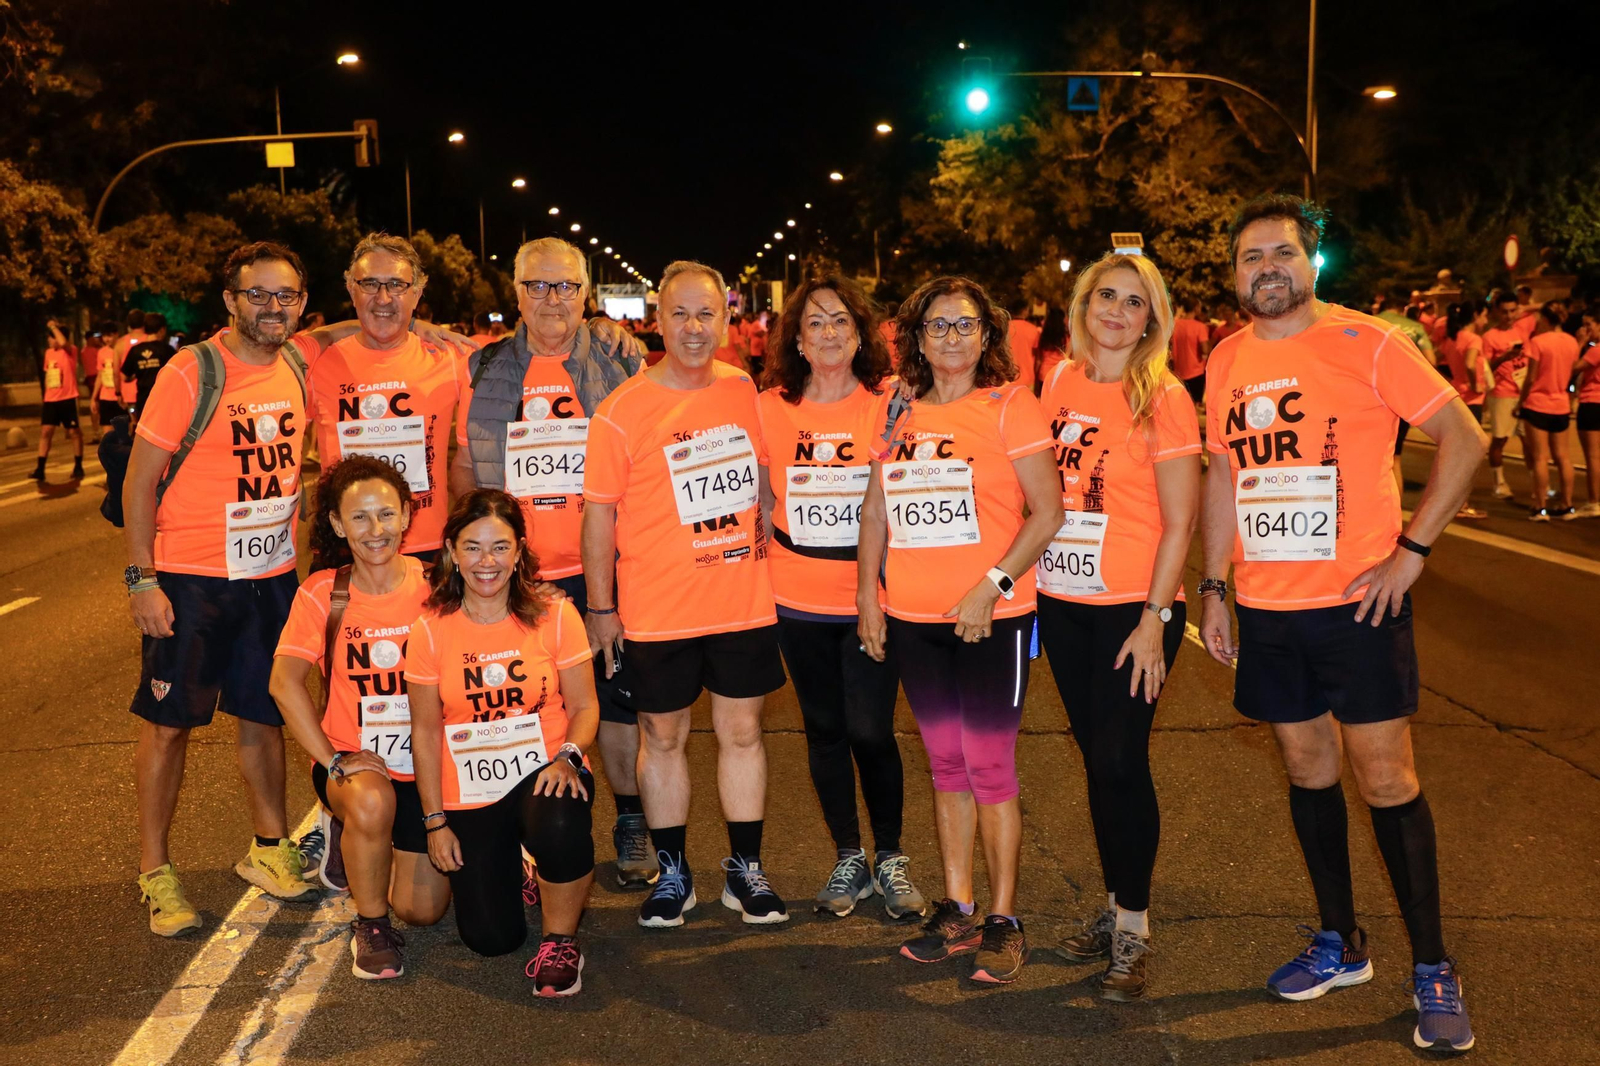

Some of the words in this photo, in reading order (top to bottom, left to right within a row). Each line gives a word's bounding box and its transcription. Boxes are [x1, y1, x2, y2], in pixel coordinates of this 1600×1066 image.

[339, 383, 355, 395] 36
[357, 380, 408, 392] CARRERA
[523, 385, 570, 396] CARRERA
[1231, 386, 1244, 403] 36
[1245, 377, 1299, 396] CARRERA
[227, 403, 246, 416] 36
[248, 400, 292, 414] CARRERA
[1057, 407, 1069, 417] 36
[1069, 411, 1101, 424] CARRERA
[798, 431, 812, 440] 36
[813, 432, 852, 440] CARRERA
[903, 432, 914, 441] 36
[232, 442, 296, 475] TUR
[1228, 430, 1303, 469] TUR
[512, 453, 584, 478] 16342
[238, 475, 282, 502] NA
[682, 465, 754, 503] 17484
[892, 499, 970, 526] 16354
[1244, 511, 1328, 538] 16402
[692, 532, 748, 548] Guadalquivir
[345, 626, 362, 640] 36
[364, 624, 414, 637] CARRER
[463, 653, 477, 664] 36
[479, 649, 521, 662] CARRERA
[466, 687, 526, 712] TUR
